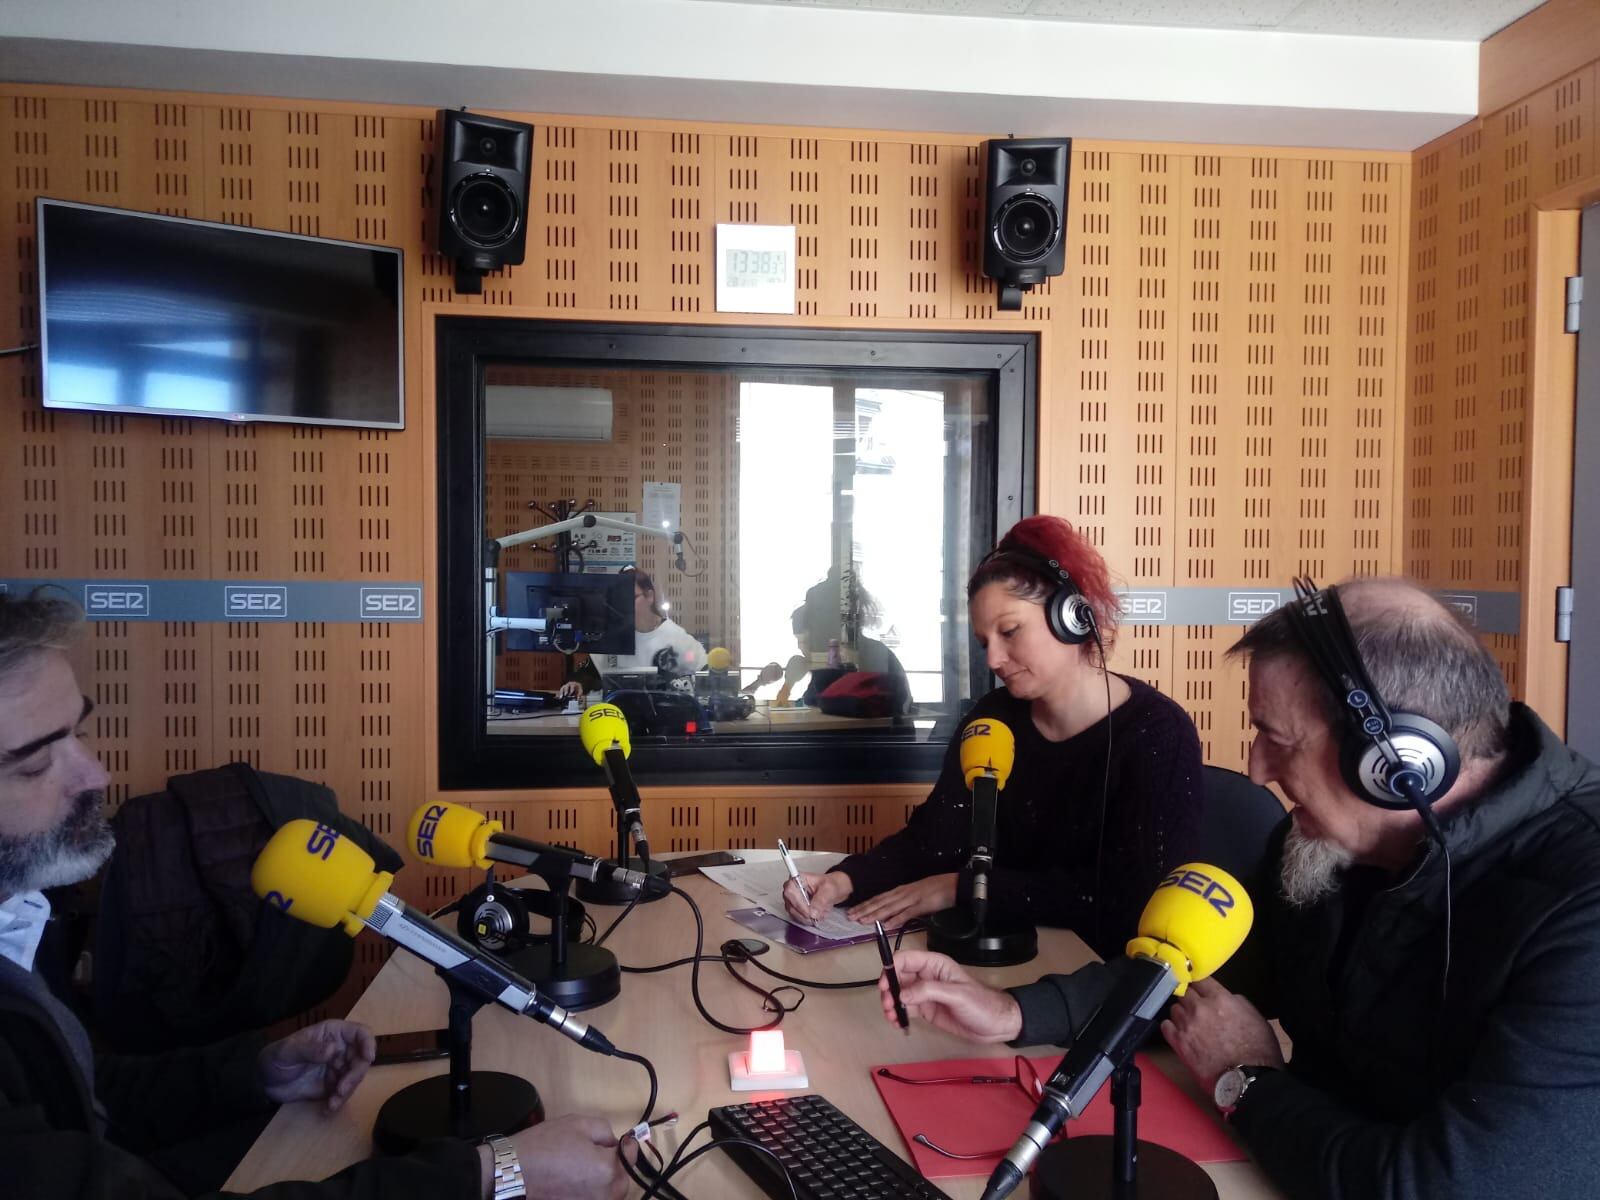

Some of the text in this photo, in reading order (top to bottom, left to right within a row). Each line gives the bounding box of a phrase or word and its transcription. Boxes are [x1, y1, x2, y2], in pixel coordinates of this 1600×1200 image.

[91, 592, 144, 609] SER
[230, 593, 282, 610] SER
[365, 594, 416, 611] SER
[416, 805, 448, 858] SER
[1158, 870, 1235, 918] SER
